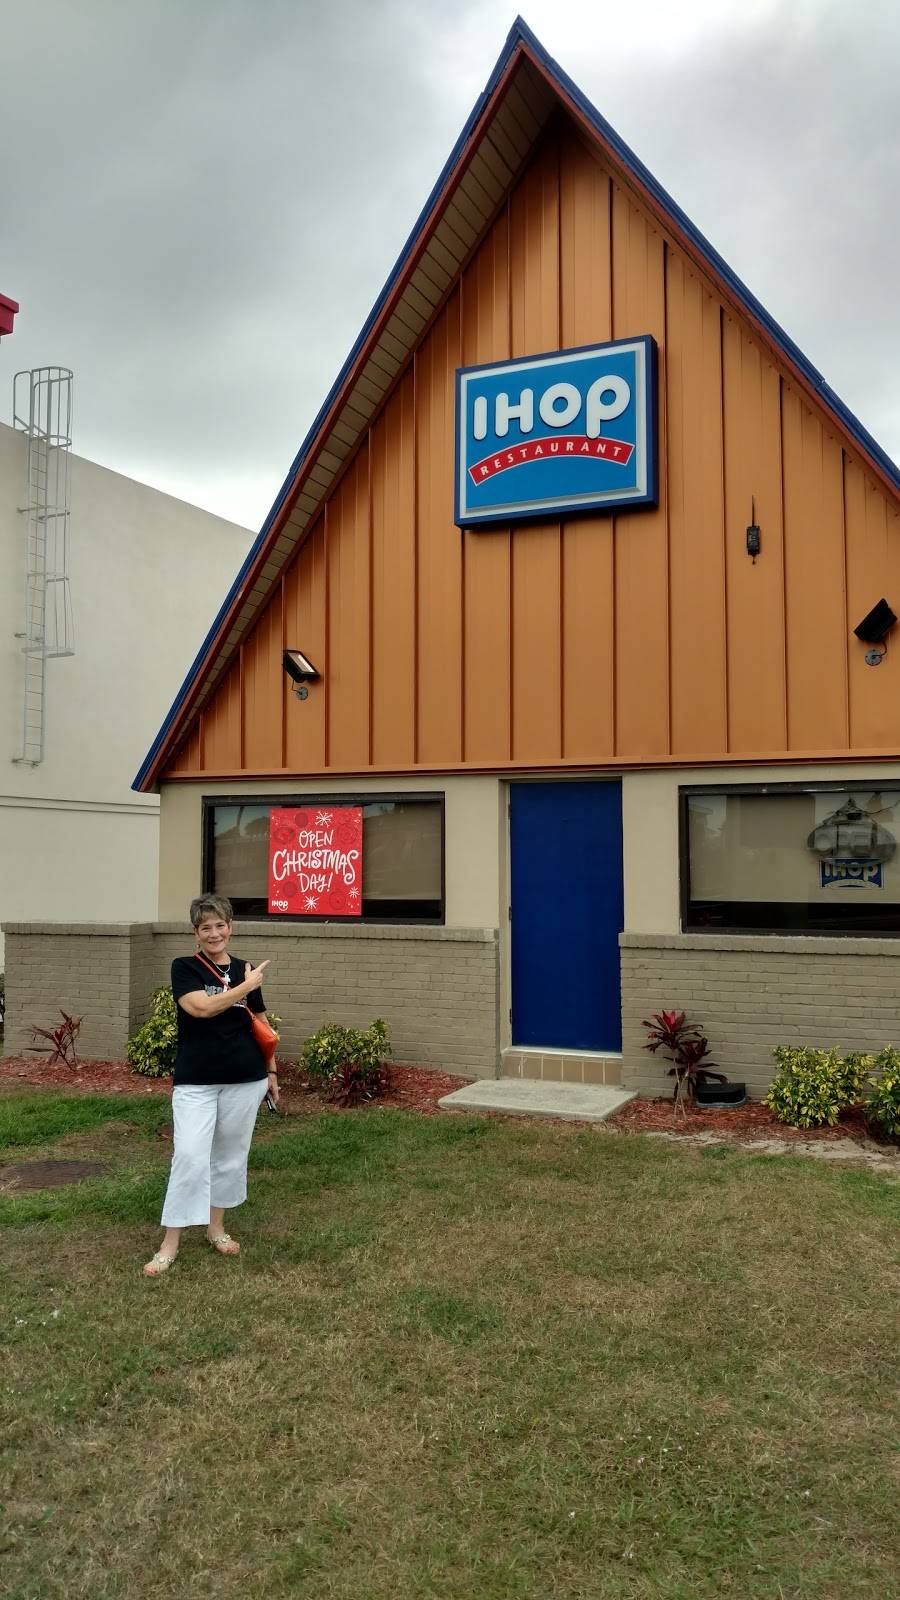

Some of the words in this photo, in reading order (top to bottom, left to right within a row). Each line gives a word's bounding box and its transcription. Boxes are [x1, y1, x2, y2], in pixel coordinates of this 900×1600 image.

[473, 375, 631, 440] IHOP
[480, 441, 622, 476] RESTAURANT
[299, 830, 334, 848] OPEN
[273, 849, 359, 885] CHRISTMAS
[297, 872, 333, 893] DAY!
